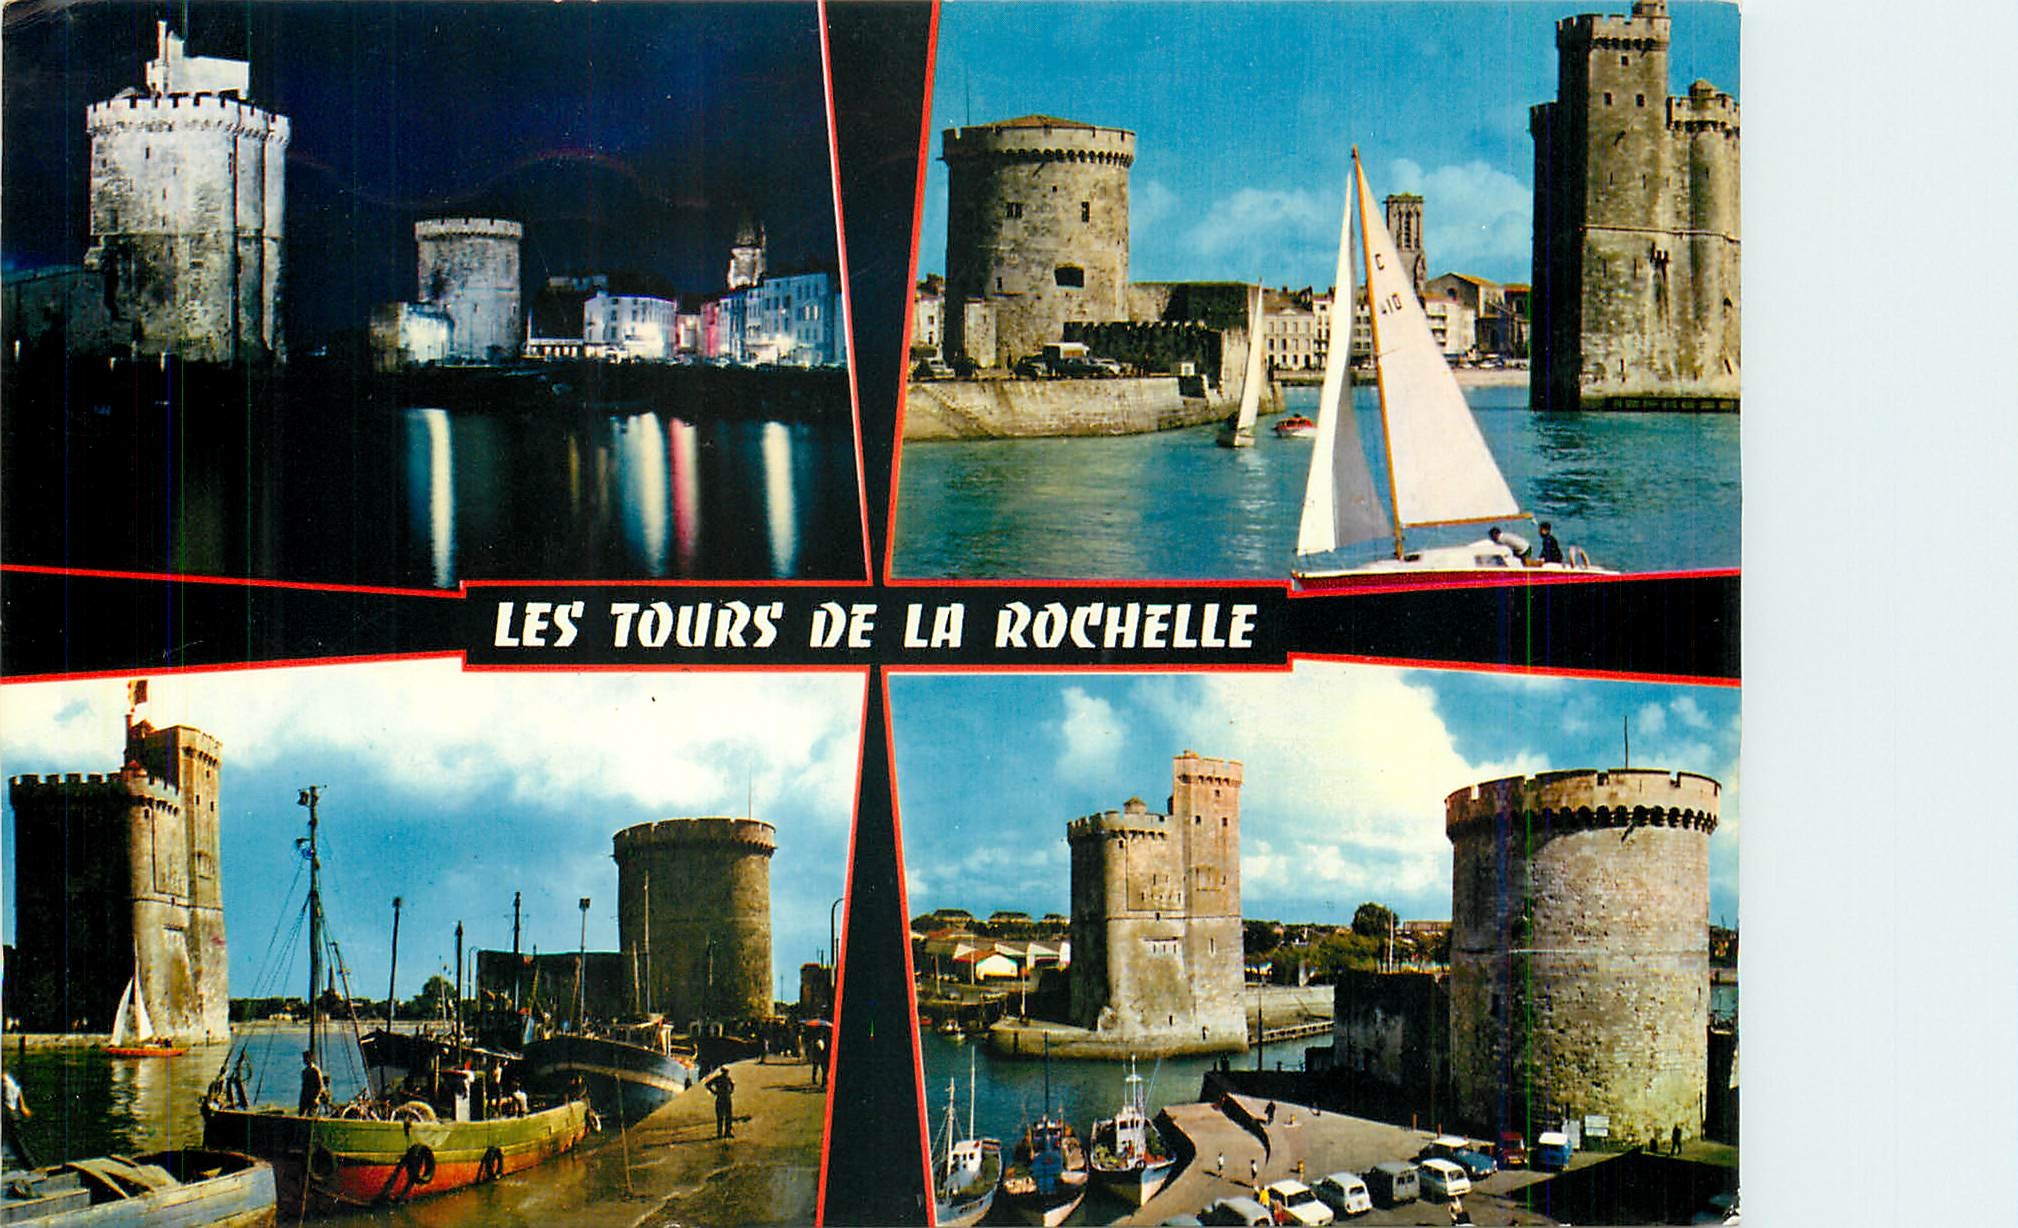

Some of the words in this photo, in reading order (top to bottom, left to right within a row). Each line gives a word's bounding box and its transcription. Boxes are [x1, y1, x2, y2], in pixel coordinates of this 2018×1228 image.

[495, 601, 584, 648] LES
[611, 602, 783, 648] TOURS
[810, 602, 877, 648] DE
[905, 602, 964, 648] LA
[996, 602, 1257, 649] ROCHELLE
